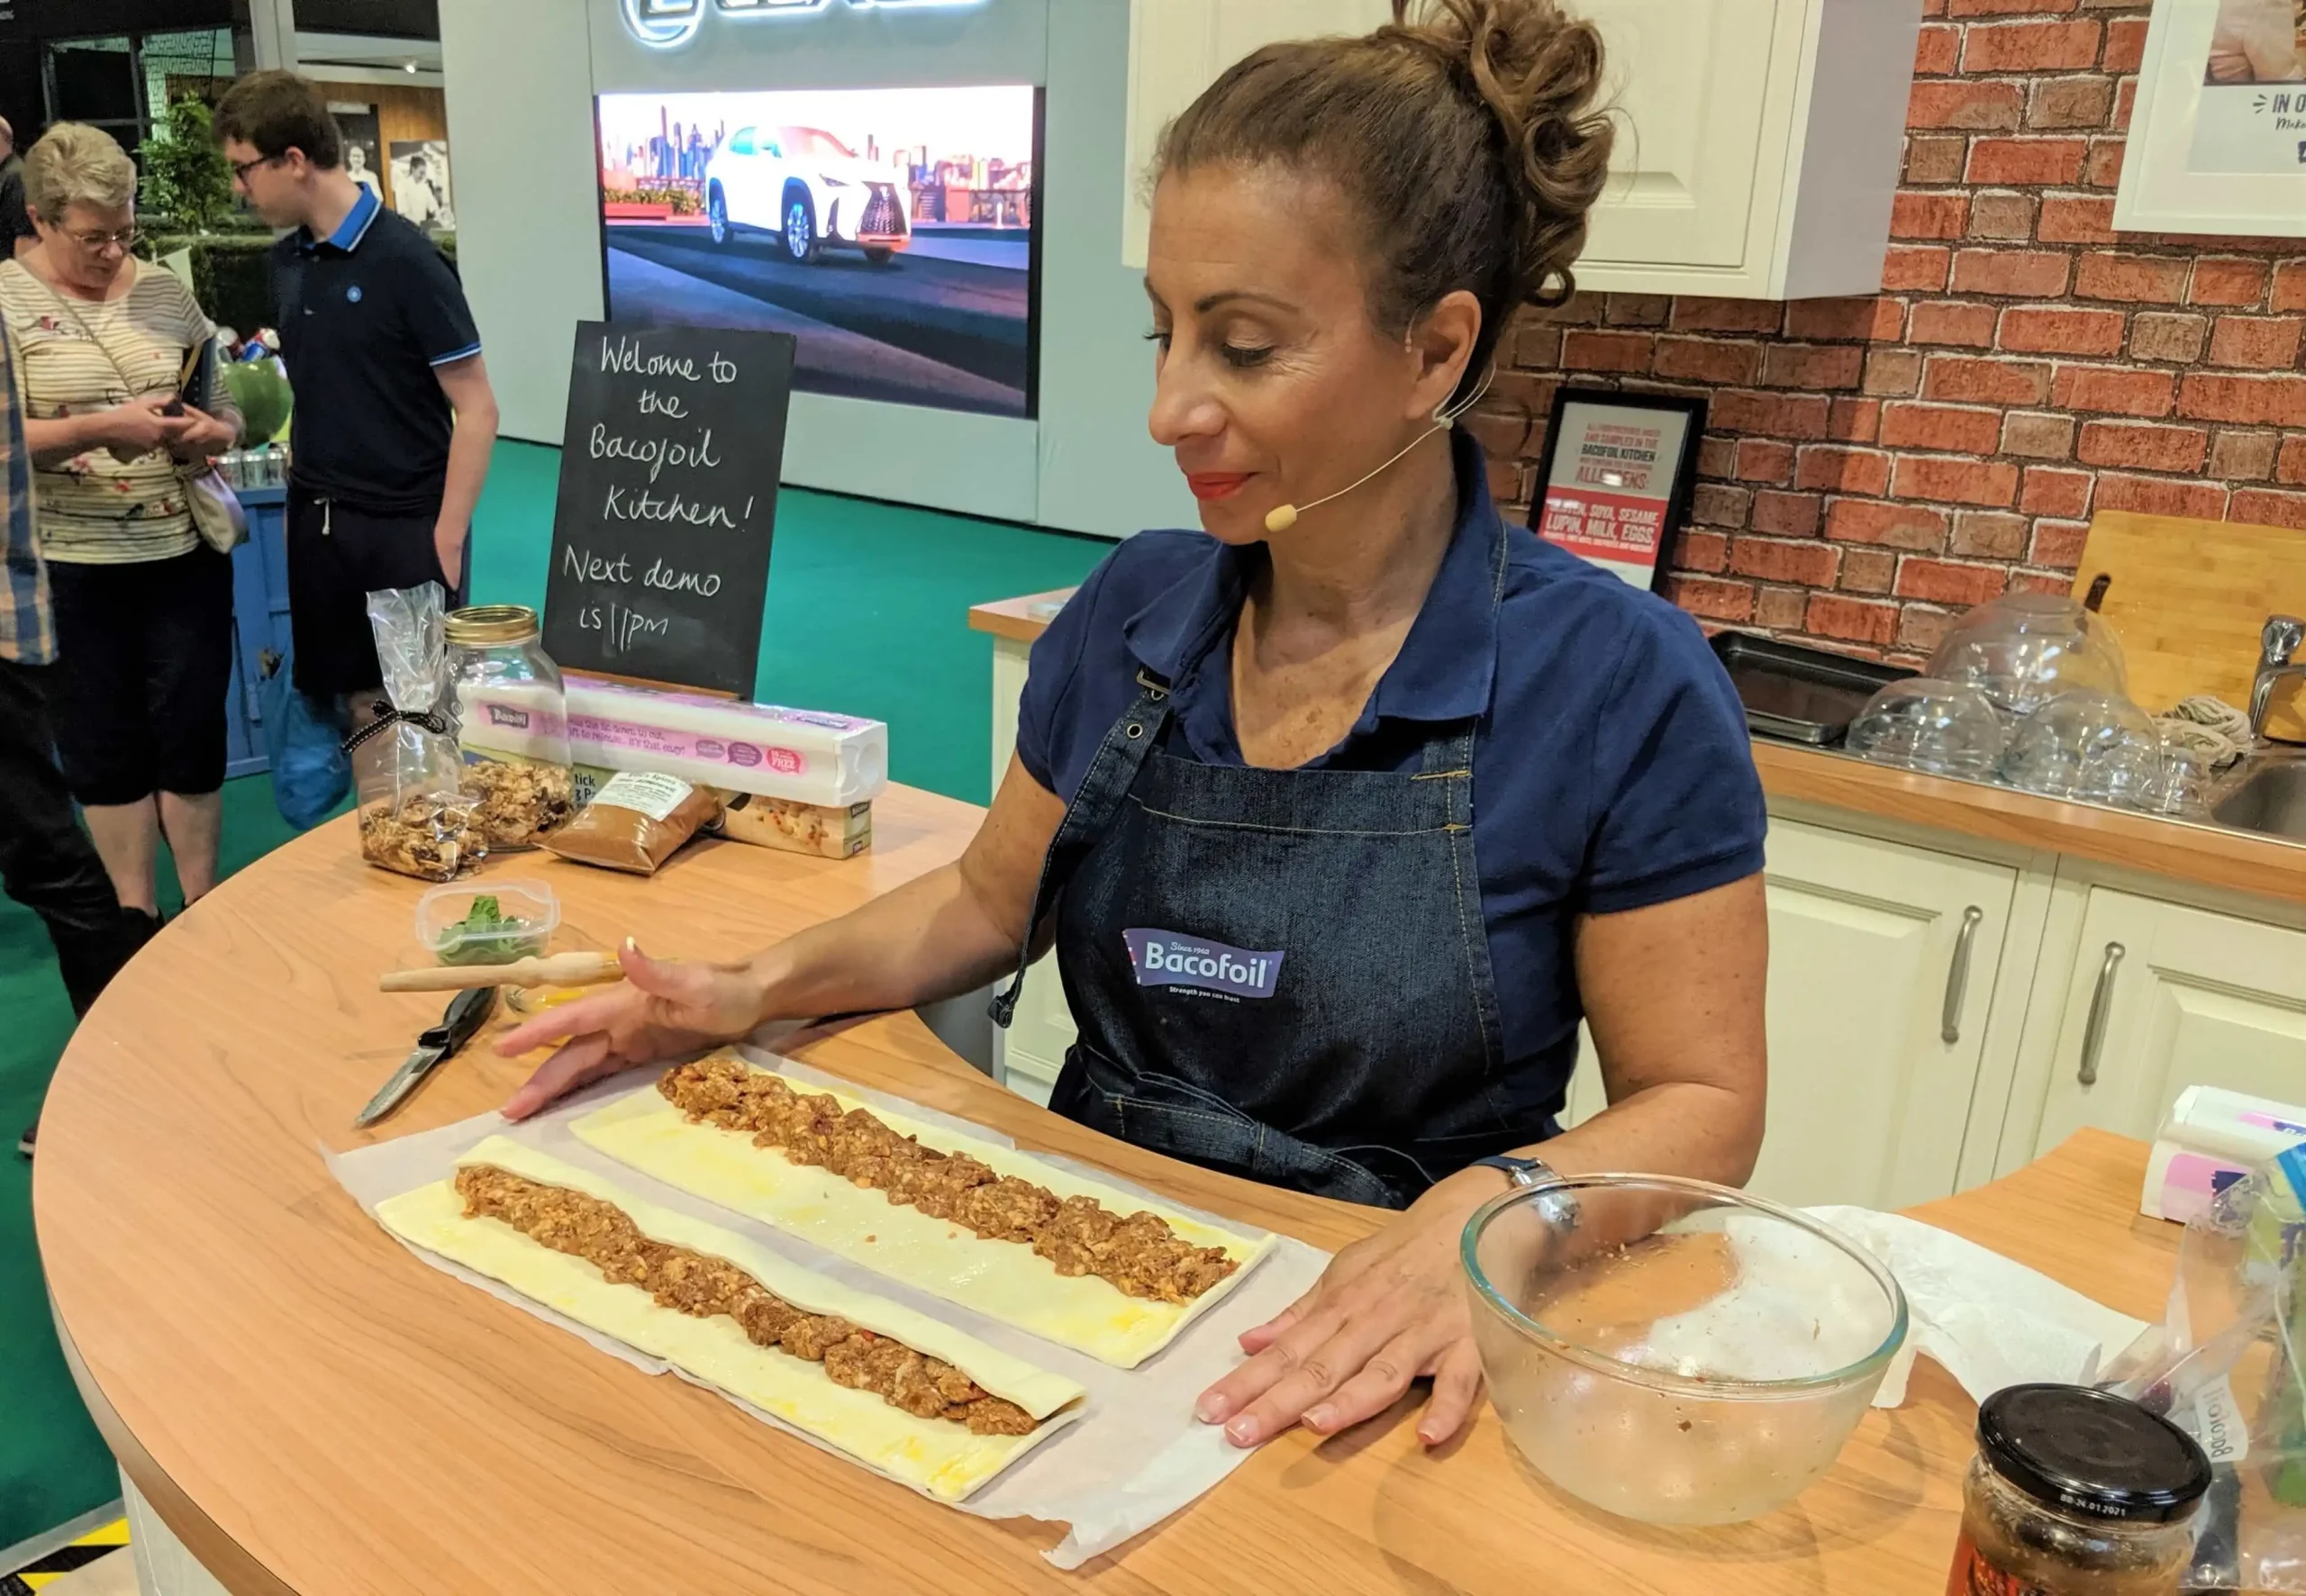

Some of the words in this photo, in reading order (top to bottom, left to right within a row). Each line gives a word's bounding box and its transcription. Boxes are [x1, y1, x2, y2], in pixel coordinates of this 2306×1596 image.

[2272, 94, 2291, 113] IN
[707, 350, 738, 383] to
[638, 389, 689, 419] the
[590, 422, 721, 484] Bacofoil
[1581, 443, 1619, 458] BACOFOIL
[1620, 449, 1657, 462] KITCHEN
[1575, 466, 1649, 490] ALLEENS:
[604, 484, 754, 532] Kitchen!
[1546, 512, 1582, 535] LUPIN,
[1585, 519, 1618, 540] MILK,
[563, 544, 632, 583] Next
[644, 556, 721, 596] demo
[579, 601, 602, 630] is
[771, 755, 796, 769] FREE
[1170, 941, 1193, 953] Since
[1194, 947, 1210, 955] 1962
[1145, 941, 1267, 988] Bacofoil
[1169, 986, 1198, 997] Strength
[1212, 992, 1223, 1000] can
